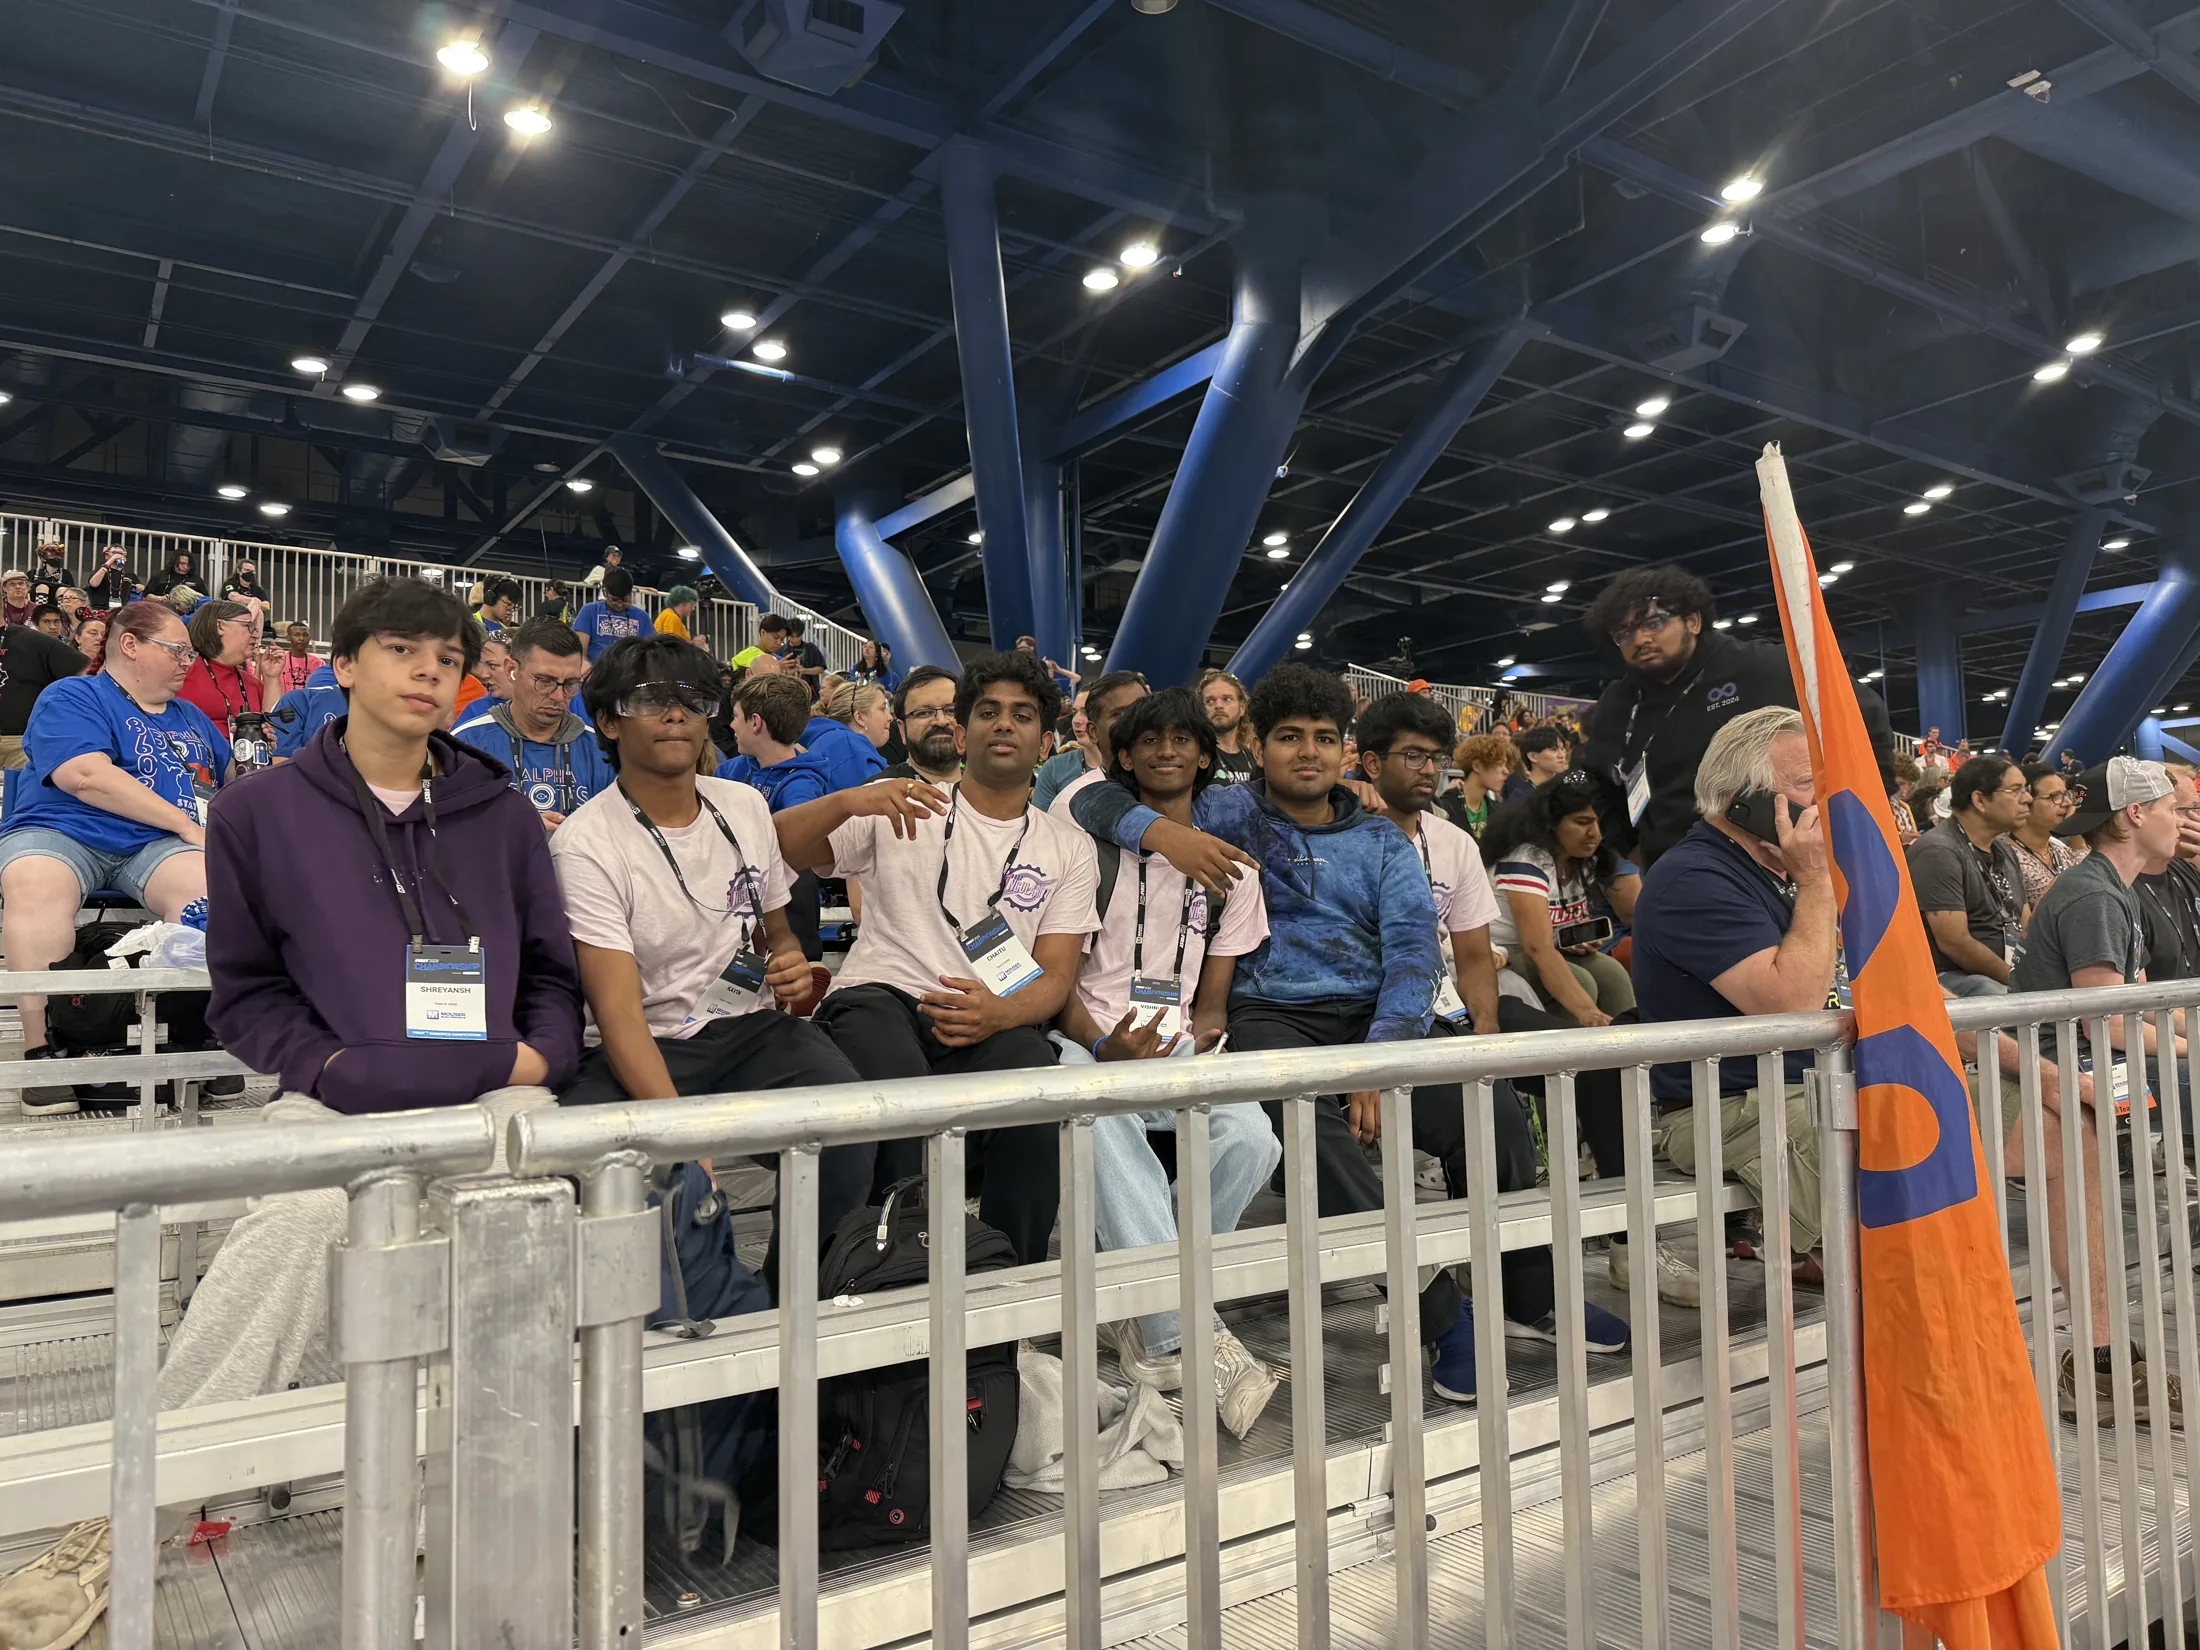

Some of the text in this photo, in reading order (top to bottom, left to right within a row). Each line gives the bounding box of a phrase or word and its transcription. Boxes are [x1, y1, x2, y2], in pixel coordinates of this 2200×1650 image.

[1706, 695, 1740, 712] EST. 2024
[986, 945, 1007, 962] CHAITU
[420, 986, 471, 994] SHREYANSH
